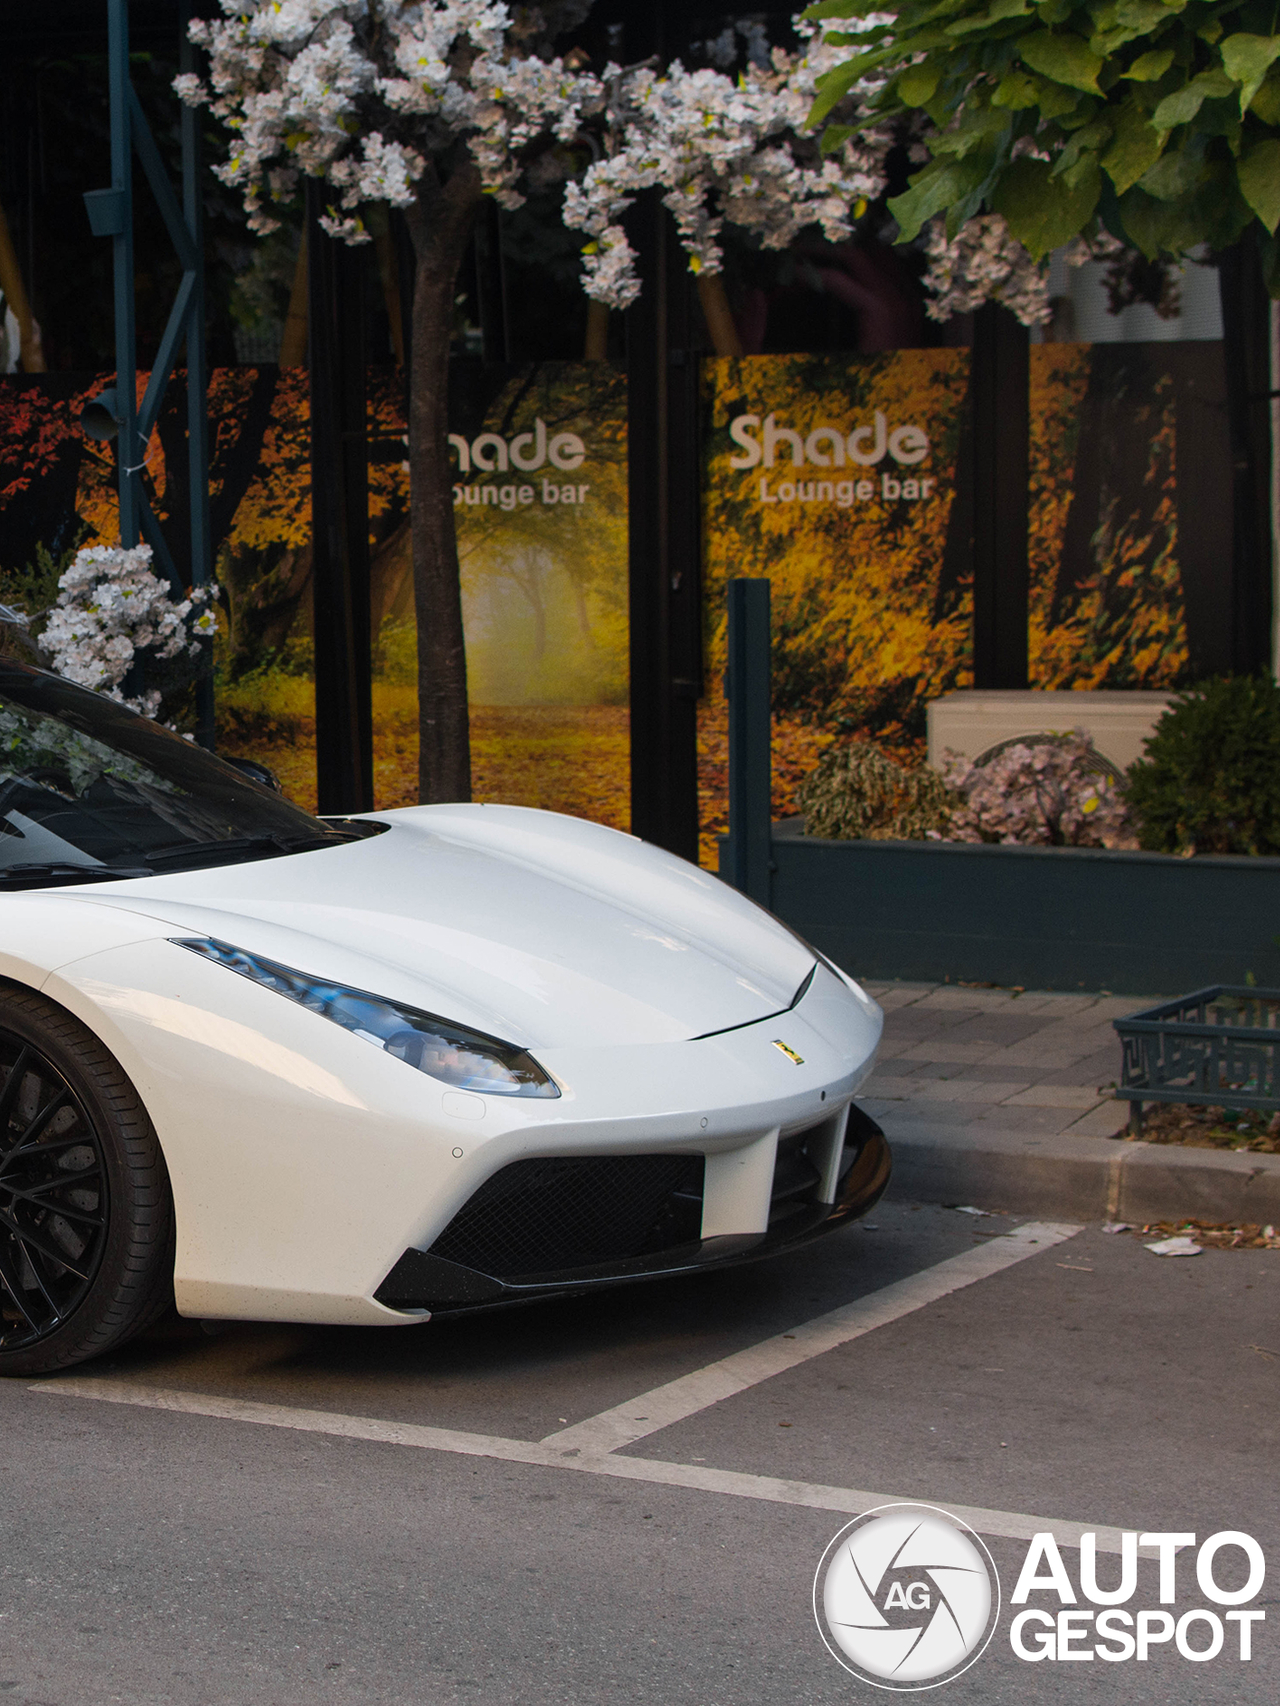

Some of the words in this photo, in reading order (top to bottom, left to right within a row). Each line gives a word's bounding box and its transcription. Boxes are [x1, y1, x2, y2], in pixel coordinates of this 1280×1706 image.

[402, 417, 586, 472] ade
[729, 410, 930, 470] Shade
[451, 484, 535, 511] ounge
[542, 478, 590, 505] bar
[760, 476, 874, 508] Lounge
[881, 472, 935, 501] bar
